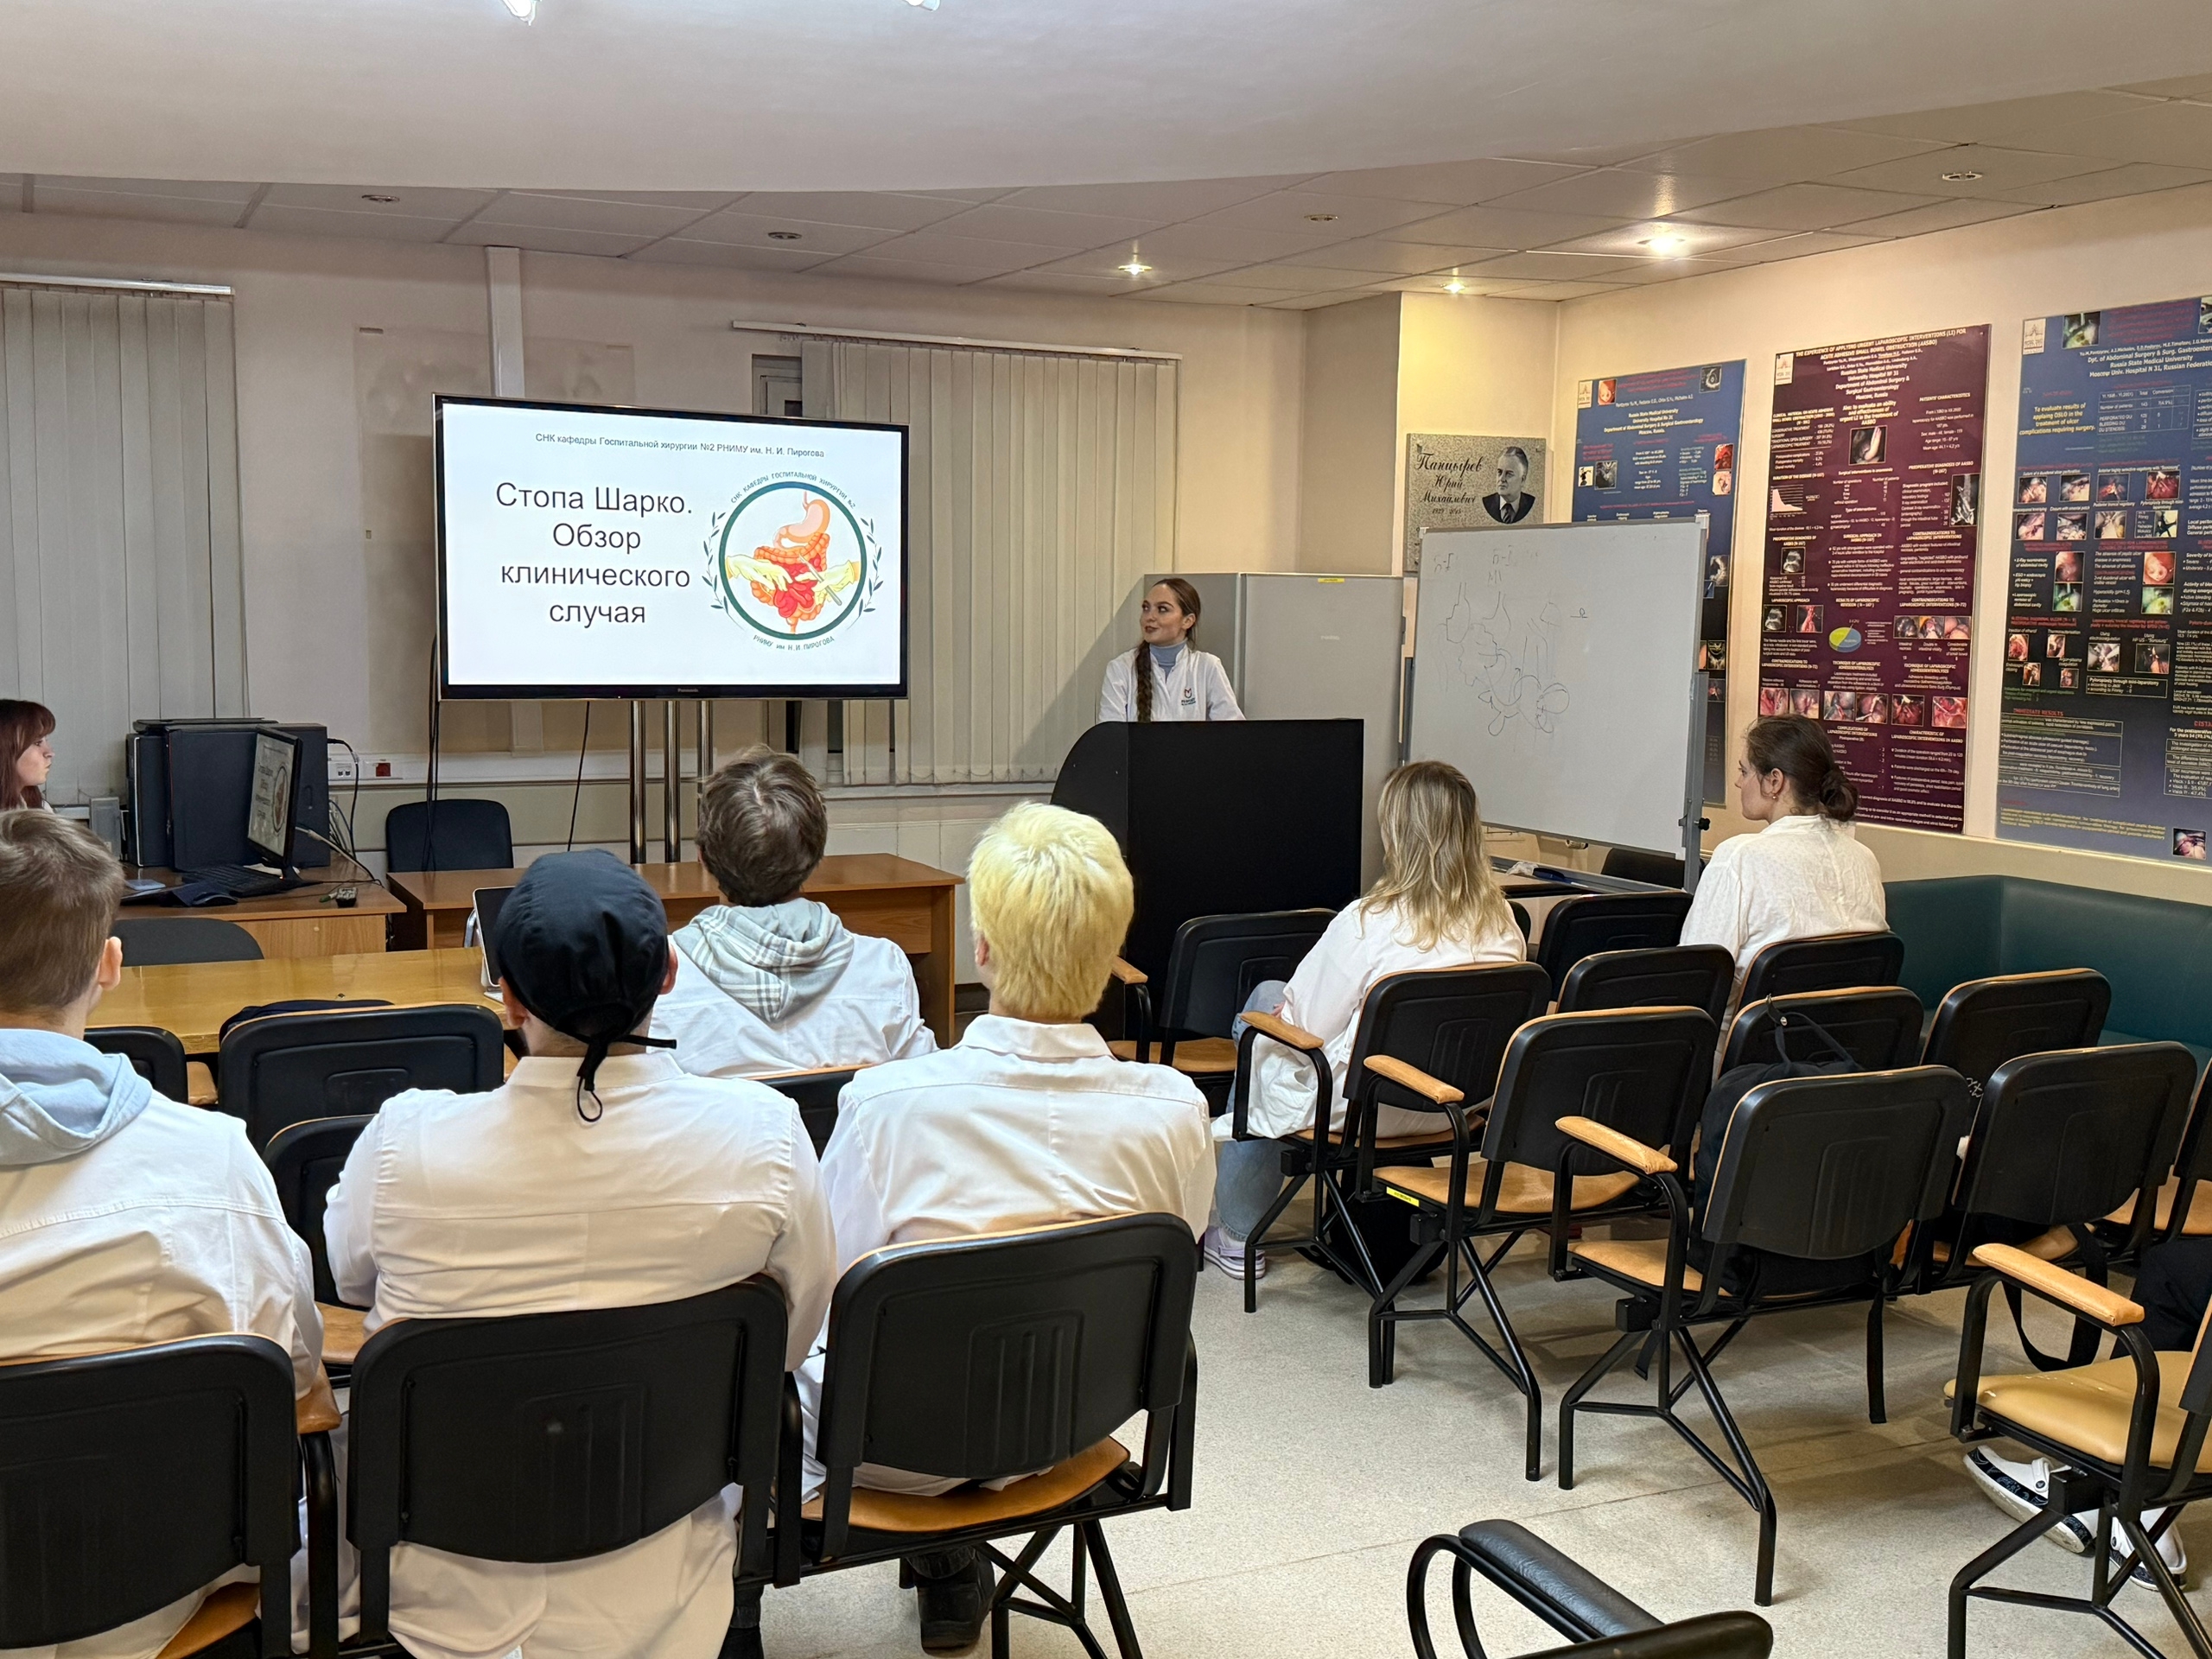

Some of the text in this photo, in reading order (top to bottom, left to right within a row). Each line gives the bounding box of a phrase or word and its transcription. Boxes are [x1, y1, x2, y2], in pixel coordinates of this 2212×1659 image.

[1909, 331, 1946, 341] INTERVENTIONS
[2106, 353, 2133, 361] Abdominal
[2164, 354, 2193, 363] University
[2126, 366, 2147, 375] Hospital
[535, 433, 556, 442] СНК
[557, 435, 597, 446] кафедры
[599, 436, 658, 448] Госпитальной
[660, 442, 697, 451] хирургии
[700, 442, 715, 452] №2
[716, 443, 748, 454] РНИМУ
[787, 448, 824, 458] Пирогова
[1416, 453, 1483, 478] Панцырев
[742, 475, 769, 493] КАФЕДРЫ
[771, 471, 817, 482] ГОСПИТАЛЬНОЙ
[819, 478, 848, 500] ХИРУРГИИ
[1434, 474, 1462, 493] Юрий
[496, 482, 692, 518] Стопа Шарко.
[1421, 490, 1476, 504] Михайлович
[553, 523, 641, 555] Обзор
[501, 565, 690, 588] клинического
[550, 604, 645, 629] случая
[753, 634, 774, 647] РНИМУ
